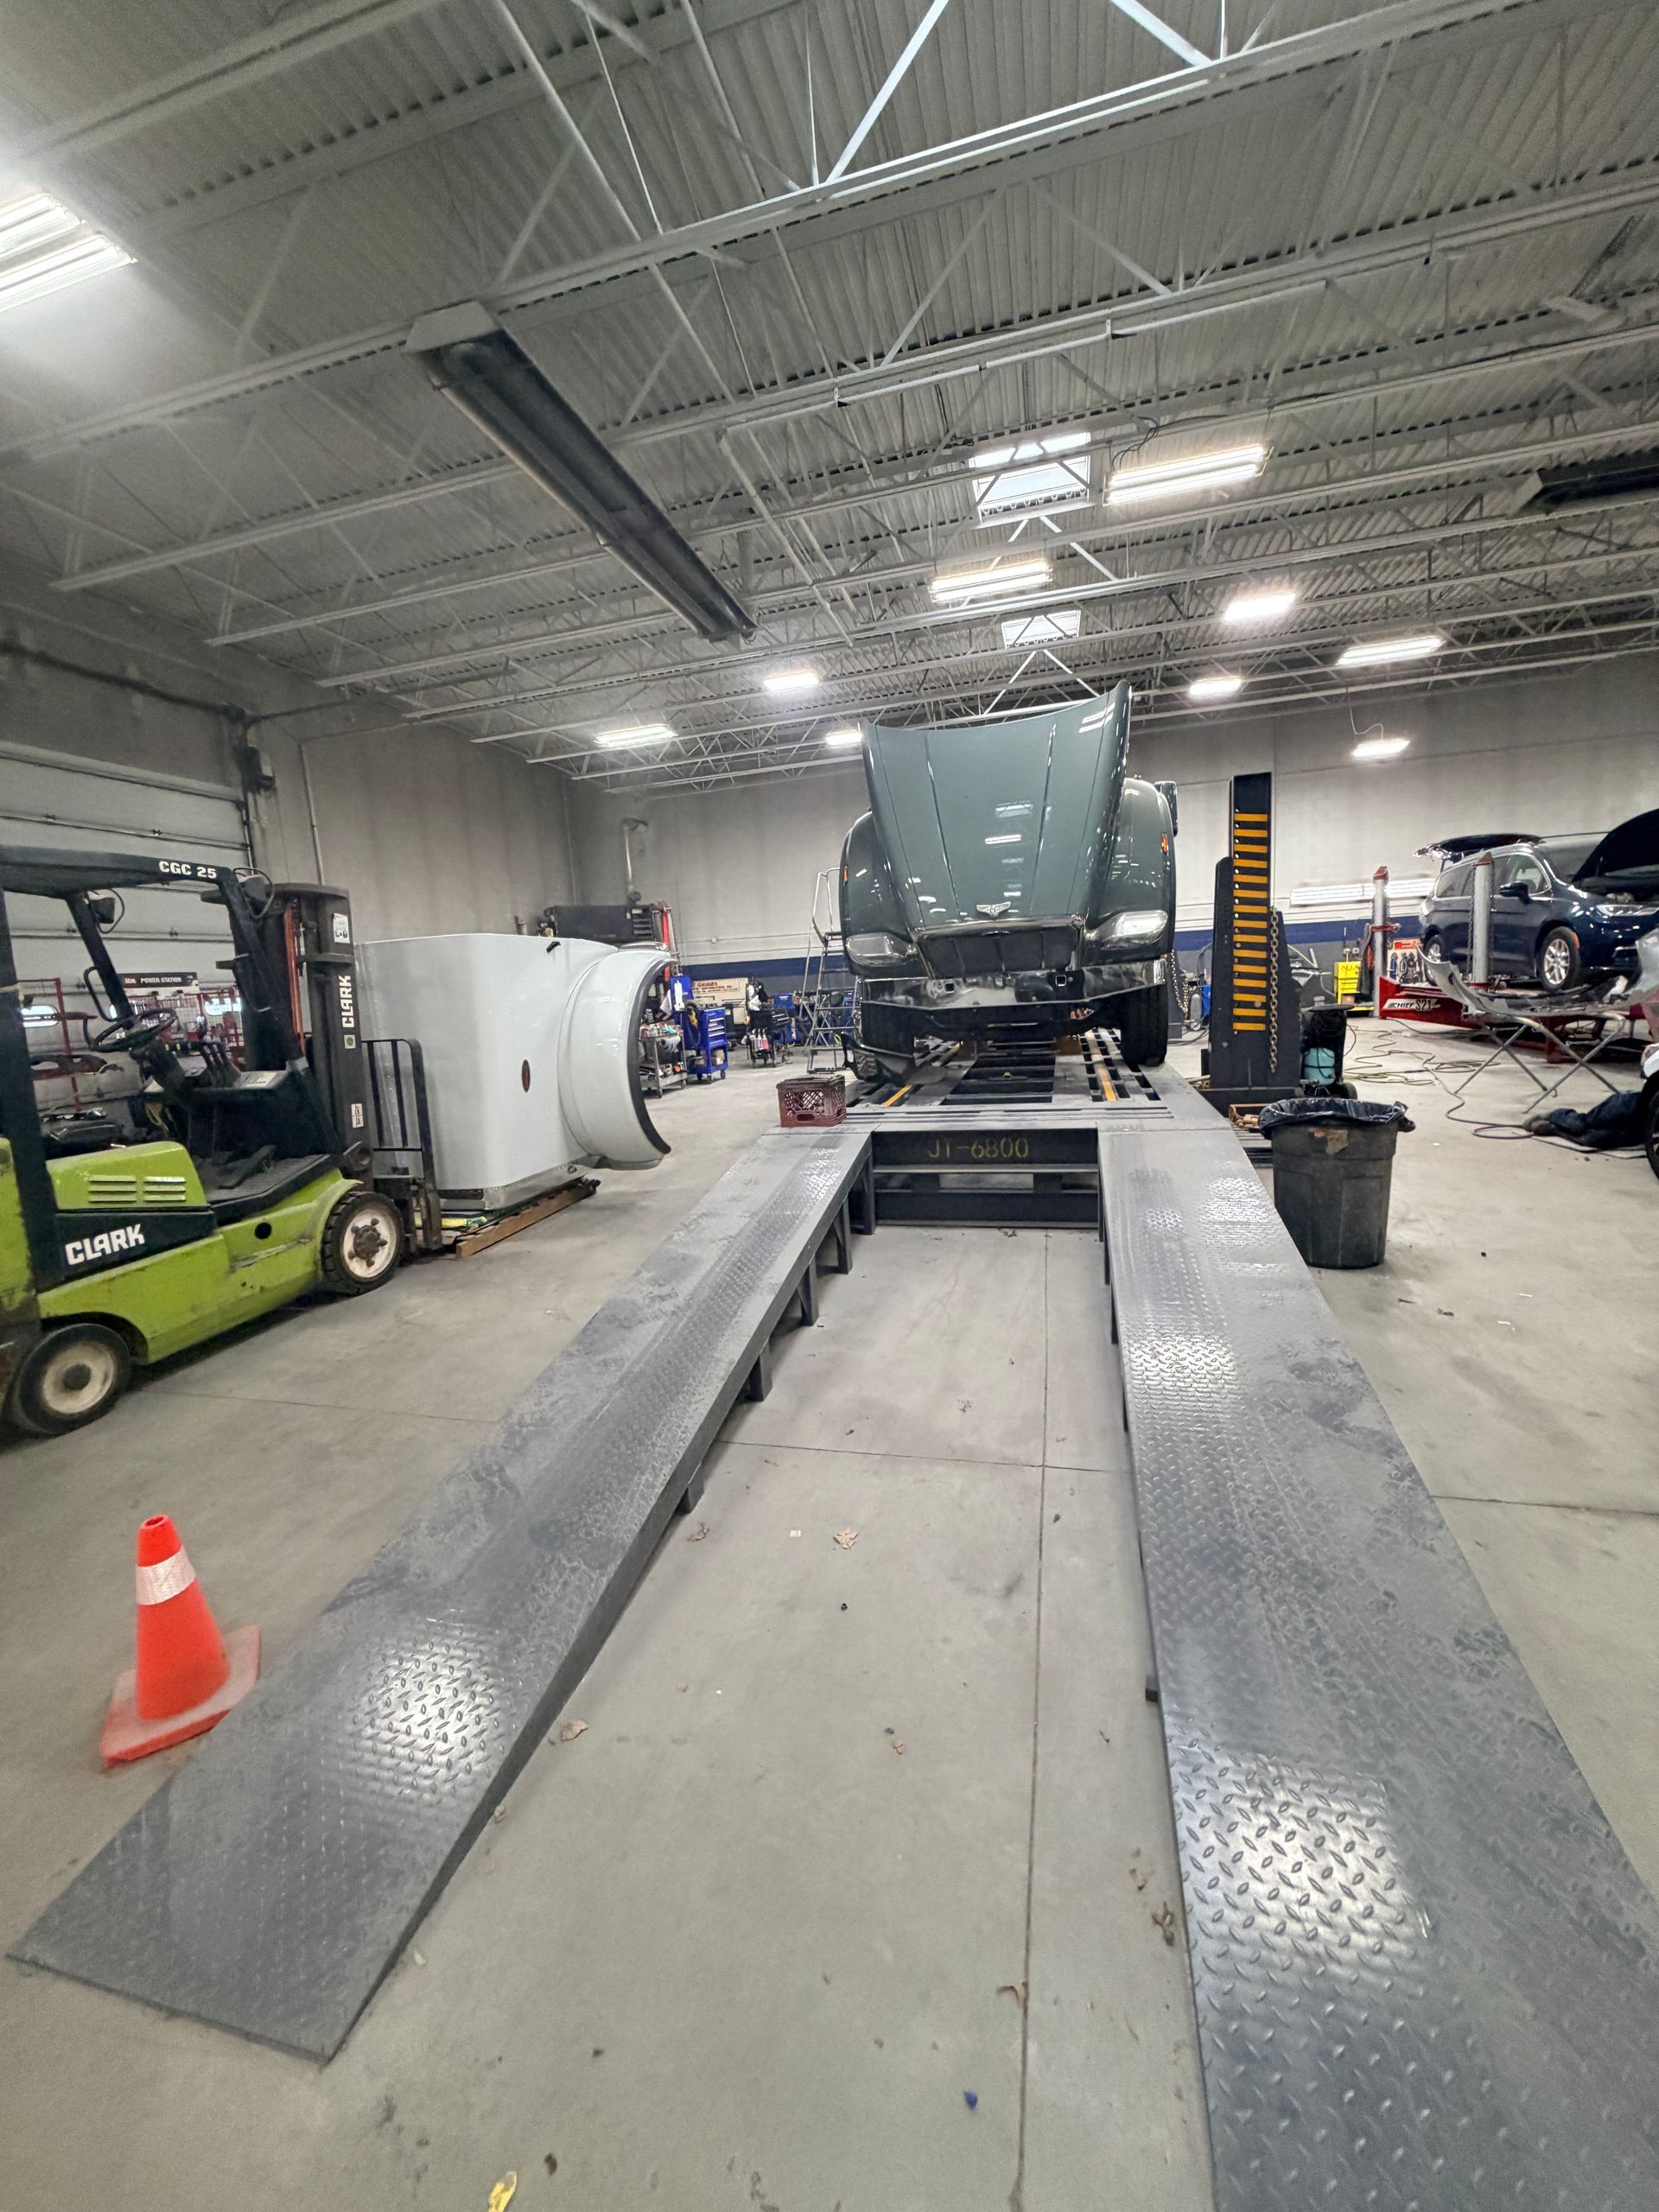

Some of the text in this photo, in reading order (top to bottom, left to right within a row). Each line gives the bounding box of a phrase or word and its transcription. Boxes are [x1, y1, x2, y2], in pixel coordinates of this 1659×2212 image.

[158, 861, 217, 879] CGC 25
[338, 975, 355, 1028] CLARK
[65, 1224, 145, 1266] CLARK
